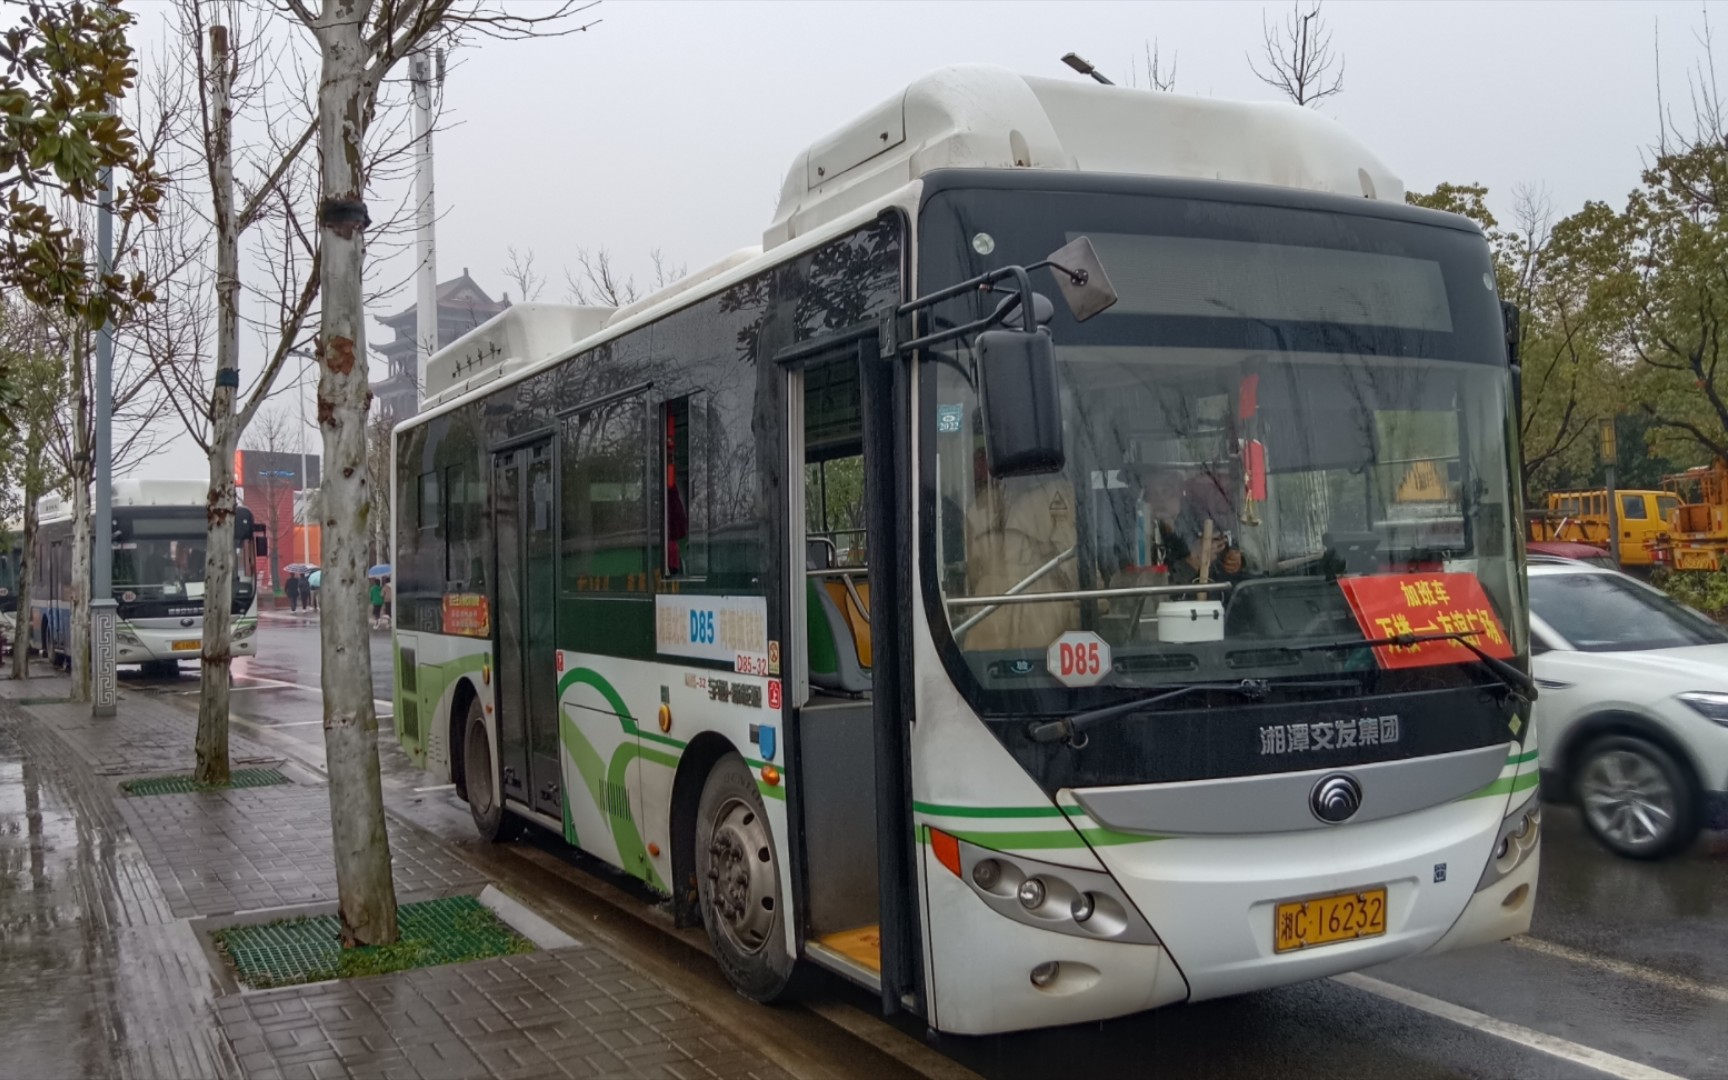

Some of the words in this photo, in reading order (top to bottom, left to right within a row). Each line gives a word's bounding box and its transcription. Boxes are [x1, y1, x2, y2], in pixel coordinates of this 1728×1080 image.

[1400, 579, 1451, 608] 加班车
[689, 608, 715, 645] D85
[737, 654, 767, 676] D85-32
[1059, 641, 1100, 677] D85
[1259, 714, 1400, 756] 湘潭交发集团
